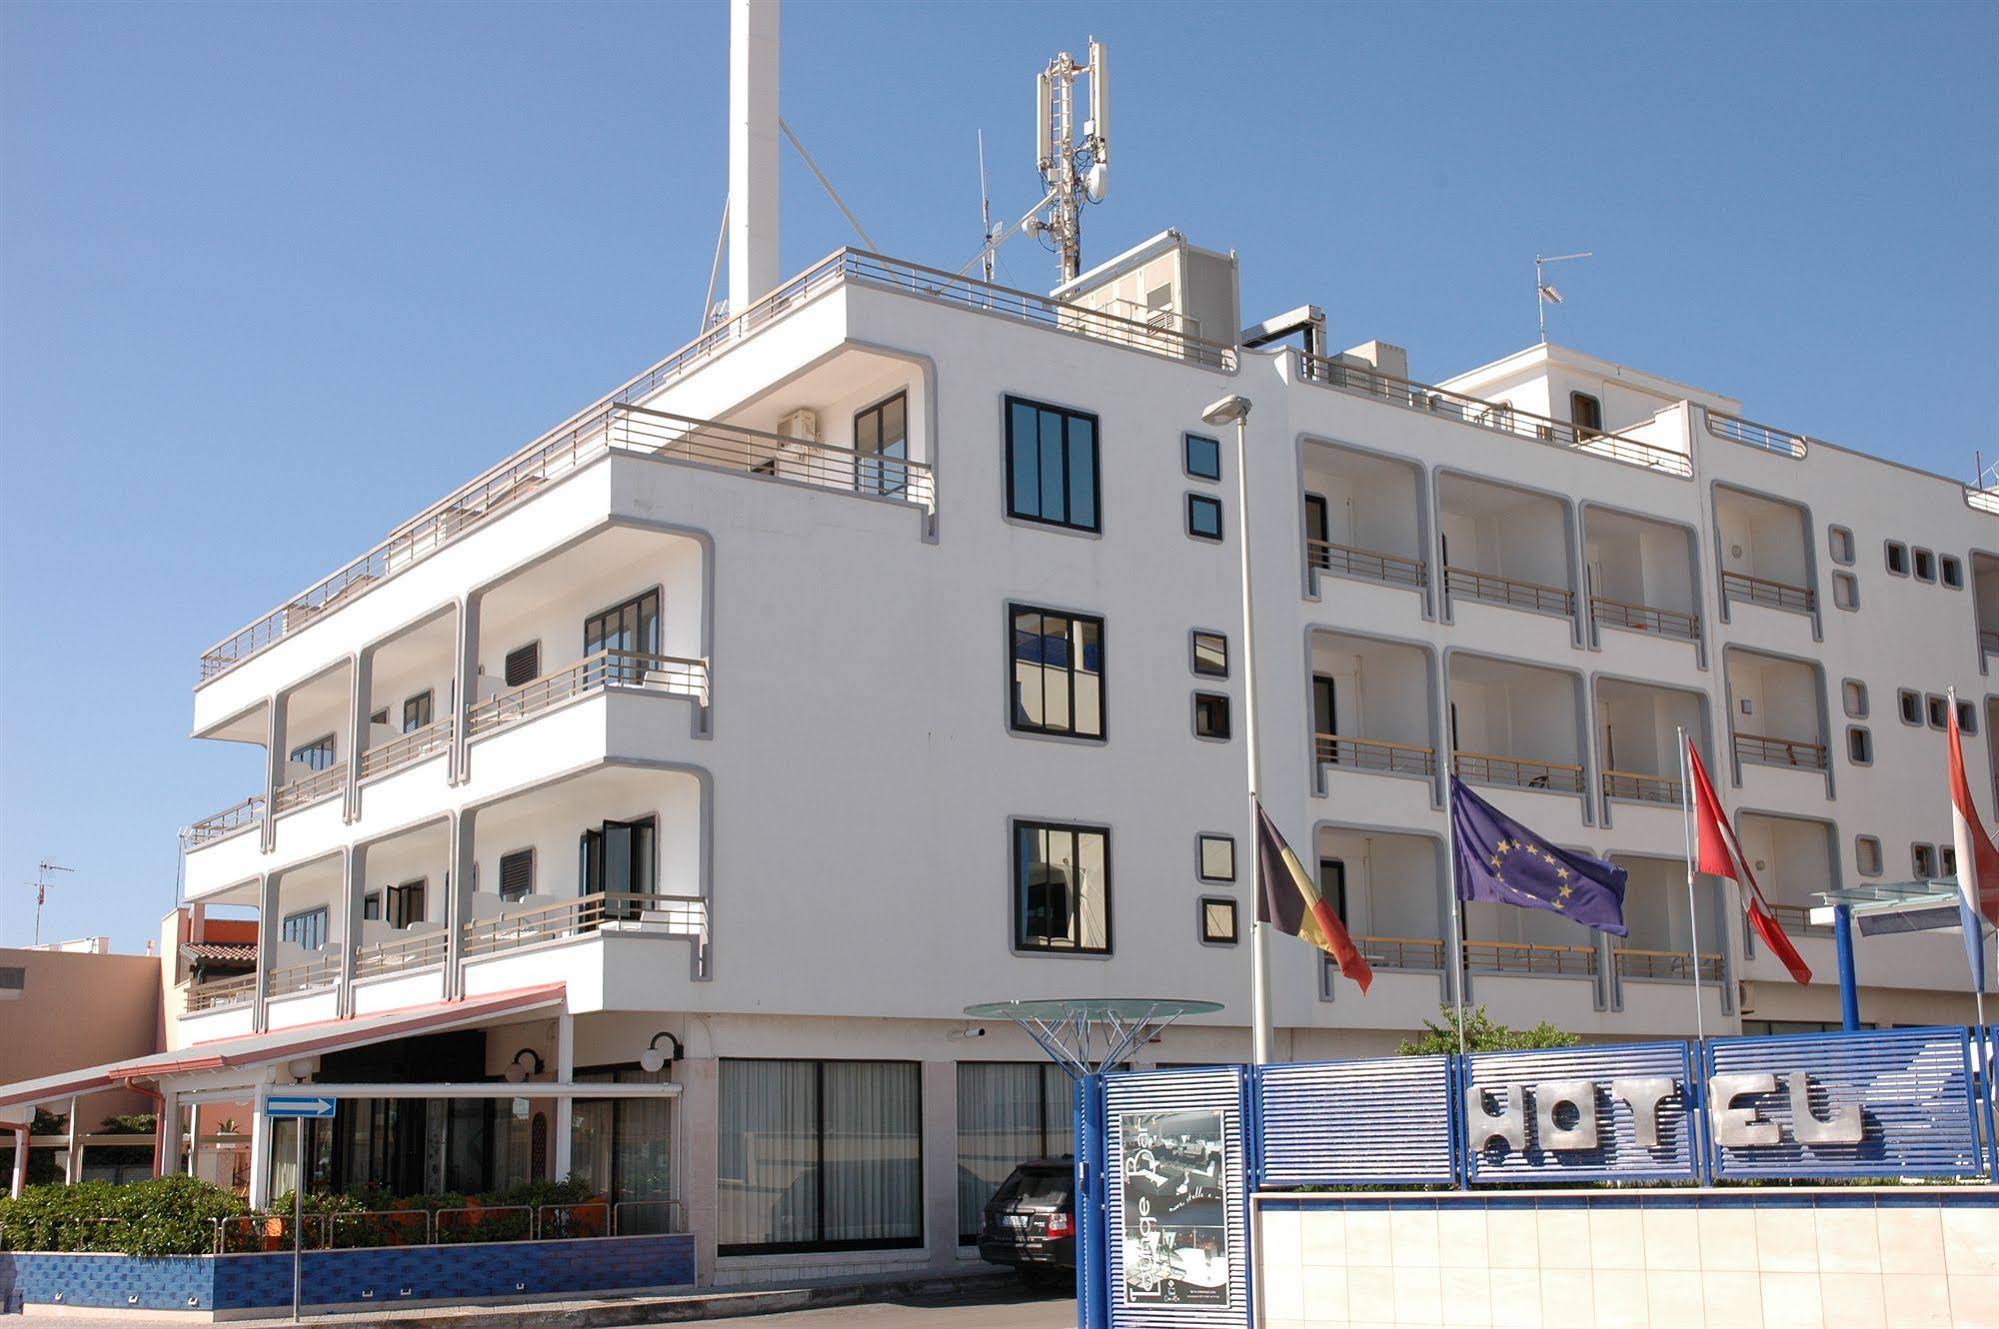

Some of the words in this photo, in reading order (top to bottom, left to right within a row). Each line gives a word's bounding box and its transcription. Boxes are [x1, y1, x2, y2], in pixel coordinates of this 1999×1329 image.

[1126, 1117, 1157, 1177] Bar
[1467, 1071, 1863, 1151] HOTEL
[1129, 1196, 1162, 1302] Lounge
